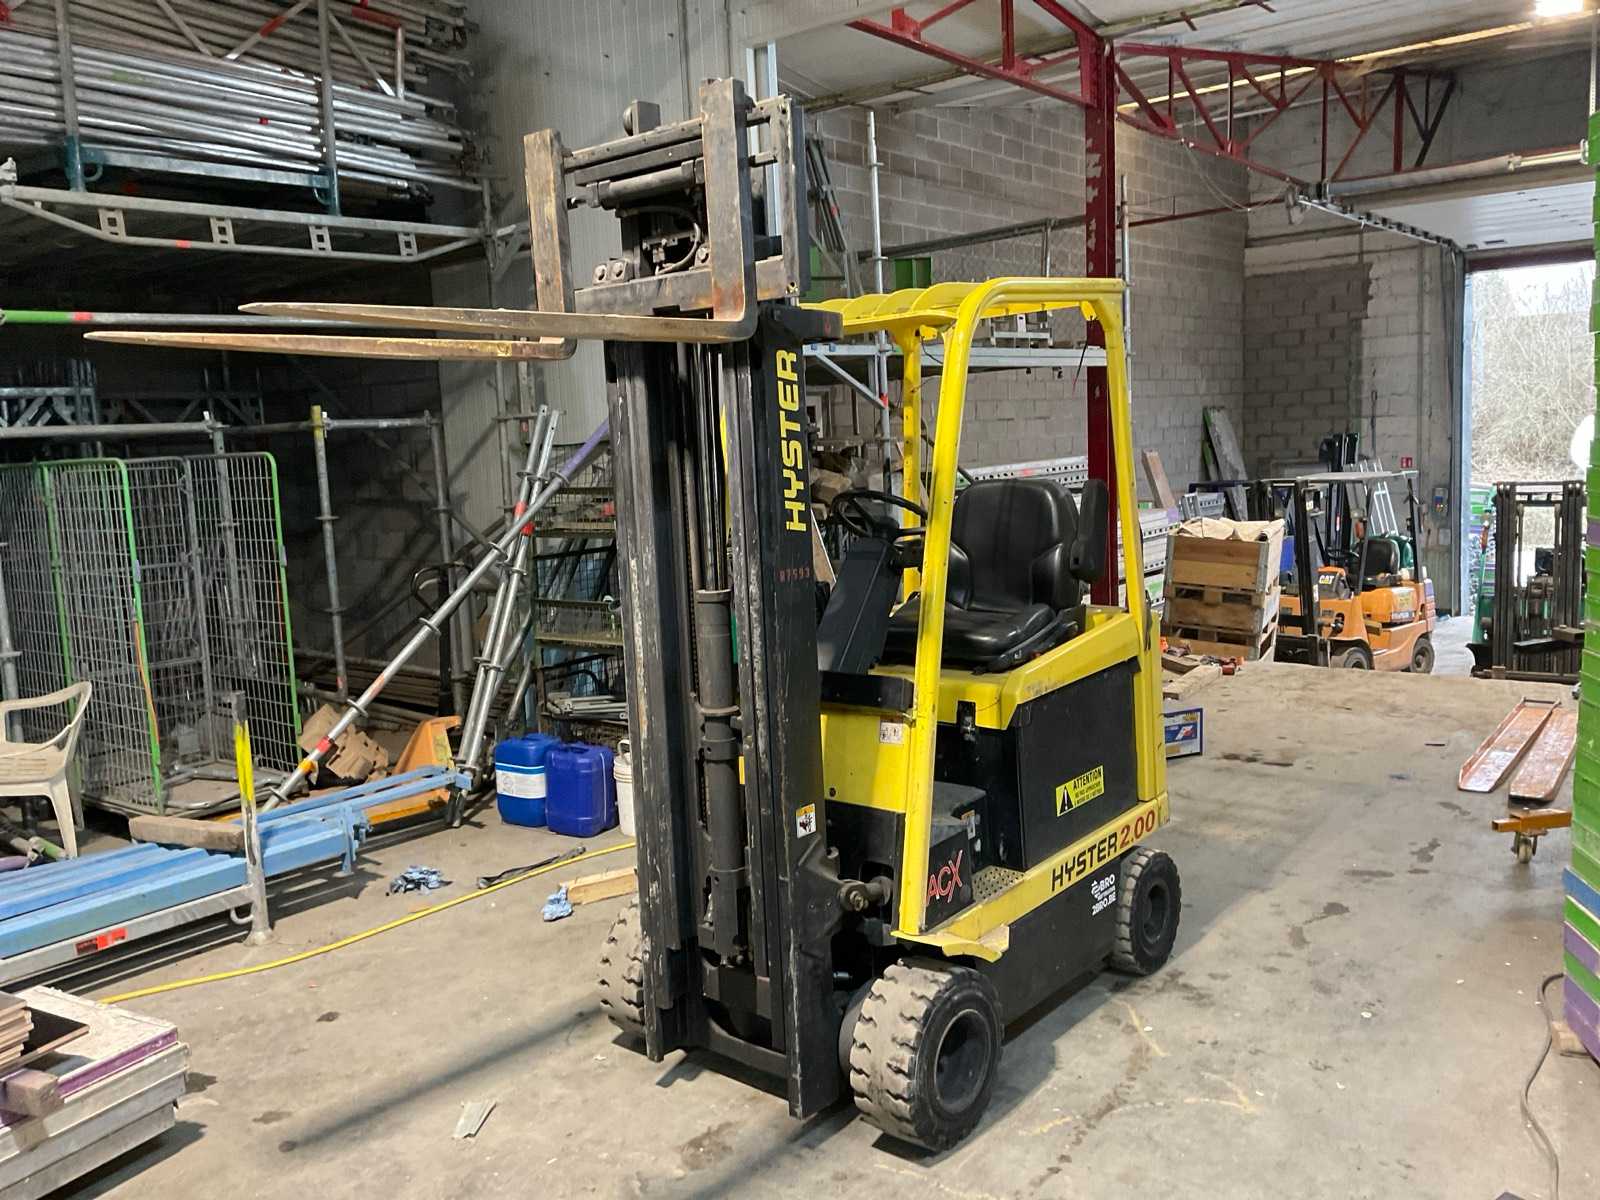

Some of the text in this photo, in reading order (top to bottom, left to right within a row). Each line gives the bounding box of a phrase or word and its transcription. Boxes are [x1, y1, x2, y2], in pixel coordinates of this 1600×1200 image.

[776, 350, 807, 531] HYSTER
[1319, 575, 1334, 584] CAT
[1073, 767, 1102, 790] ATTENTION
[927, 849, 963, 905] ACX
[1052, 810, 1155, 892] HYSTER 2.00
